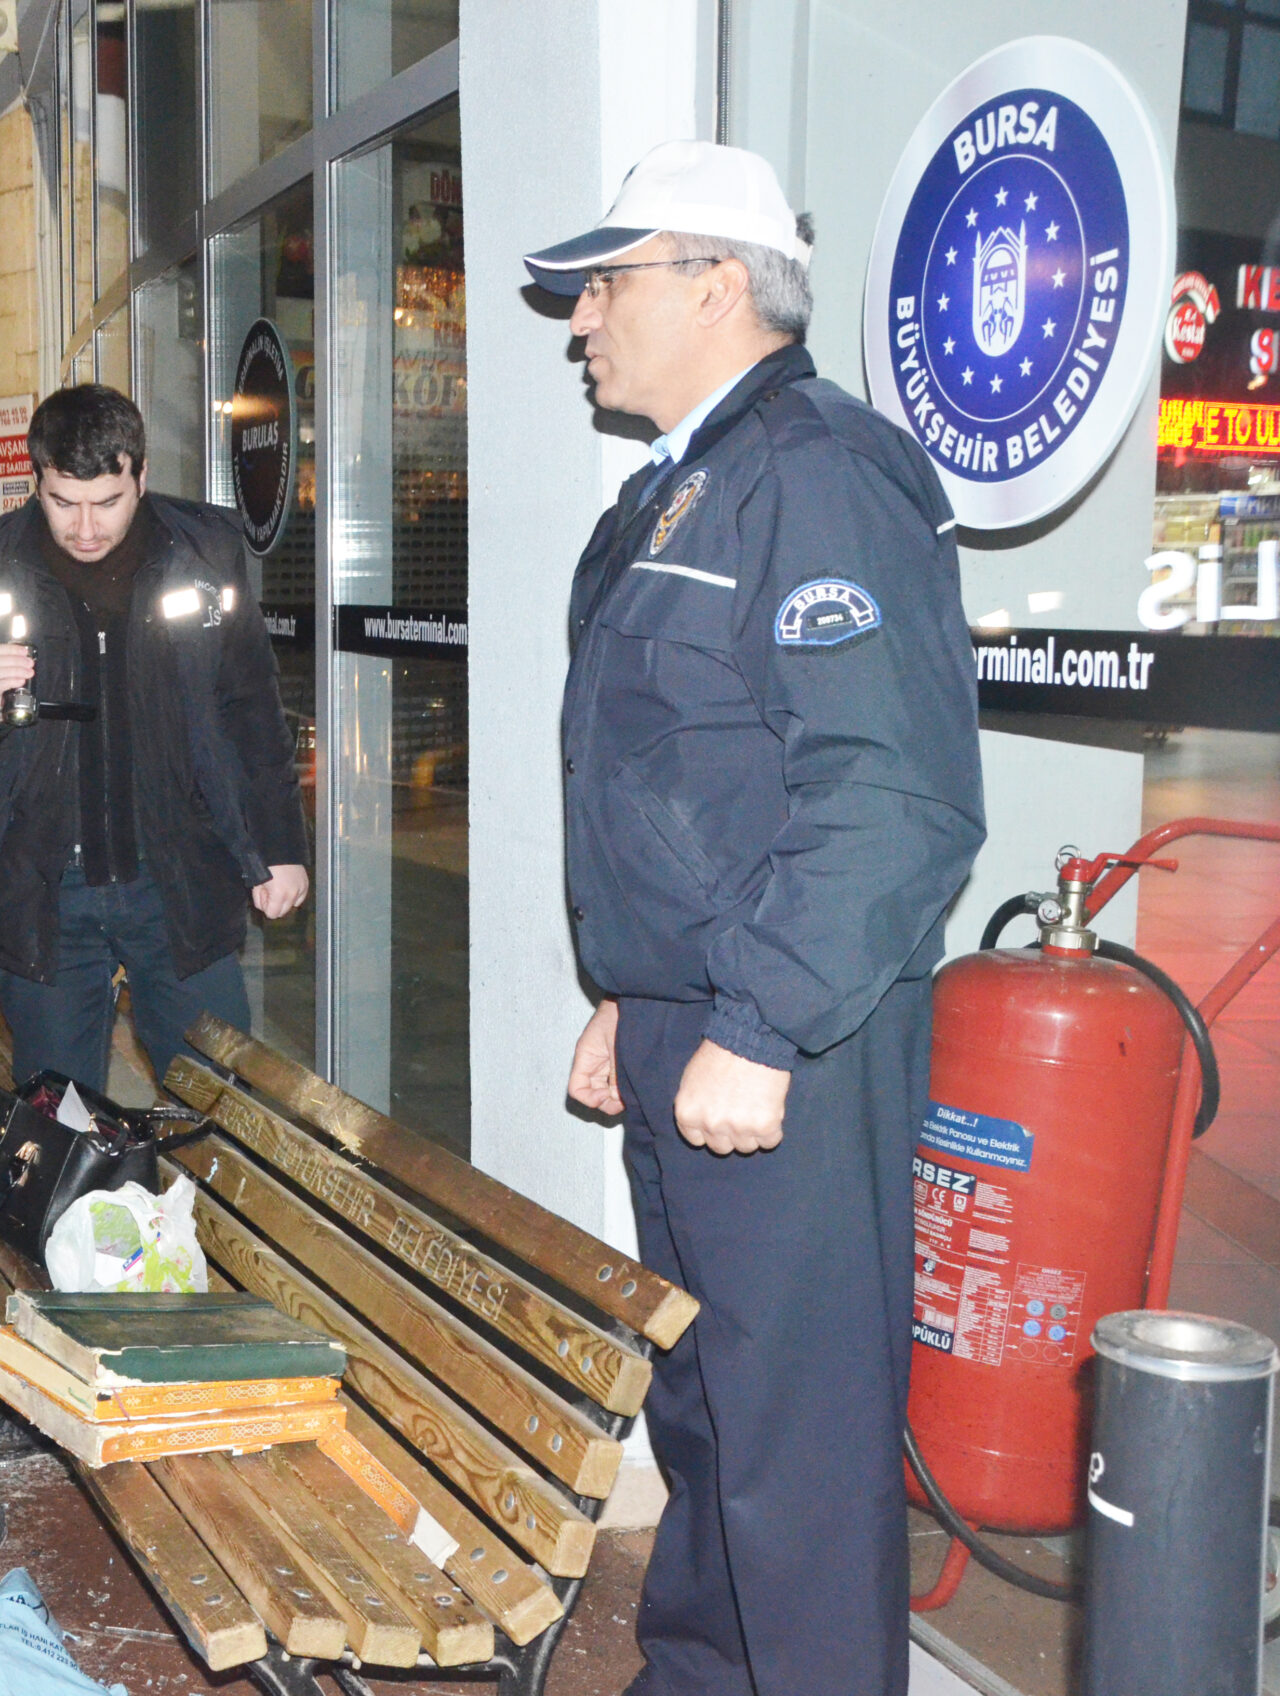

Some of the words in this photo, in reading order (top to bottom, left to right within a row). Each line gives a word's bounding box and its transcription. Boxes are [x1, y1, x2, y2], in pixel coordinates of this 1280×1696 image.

[952, 101, 1059, 174] BURSA
[896, 296, 998, 473] BÜYÜKŞEHİR
[1006, 247, 1119, 469] BELEDİYESİ
[242, 421, 279, 451] BURULAŞ
[792, 586, 850, 611] BURSA
[971, 635, 1155, 690] rminal.com.tr
[949, 1127, 976, 1143] Panosu
[977, 1137, 988, 1146] ve
[990, 1138, 1020, 1152] Elektrik
[388, 1216, 509, 1321] BELEDİYESİ
[912, 1324, 951, 1350] PÜKLÜ
